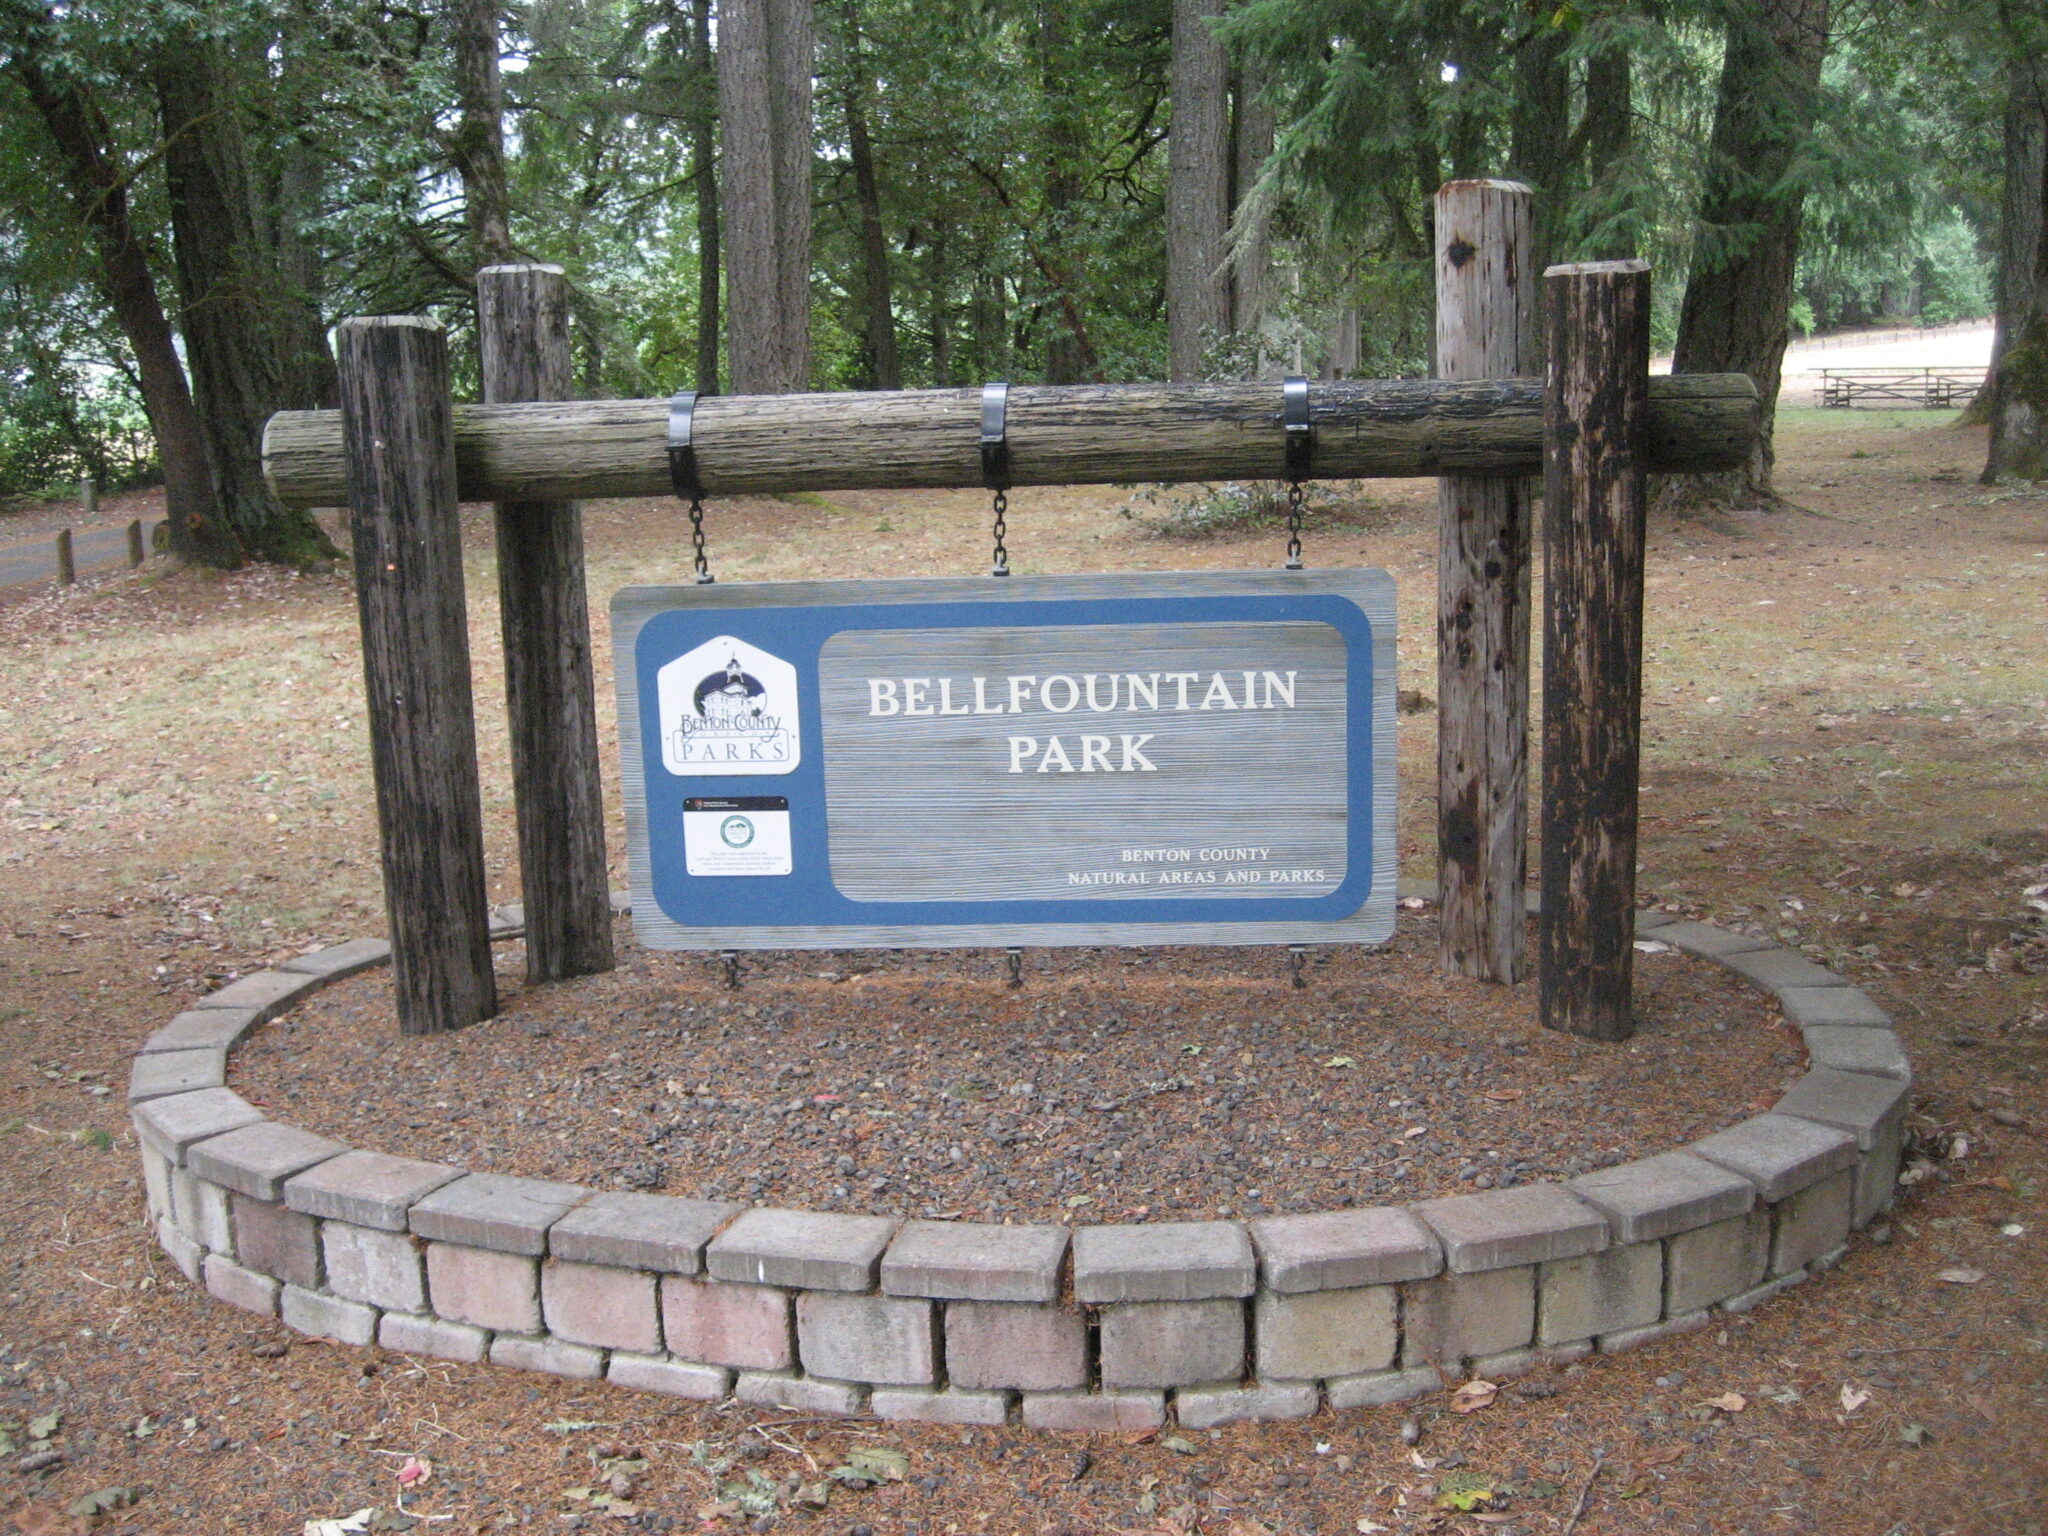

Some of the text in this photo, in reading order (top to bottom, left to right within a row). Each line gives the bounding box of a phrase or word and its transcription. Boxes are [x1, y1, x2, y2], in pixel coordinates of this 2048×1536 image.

[866, 670, 1298, 717] BELLFOUNTAIN
[681, 742, 784, 760] PARKS
[1007, 733, 1159, 774] PARK
[1121, 848, 1271, 862] BENTON COUNTY
[1068, 870, 1326, 885] NATURAL AREAS AND PARKS
